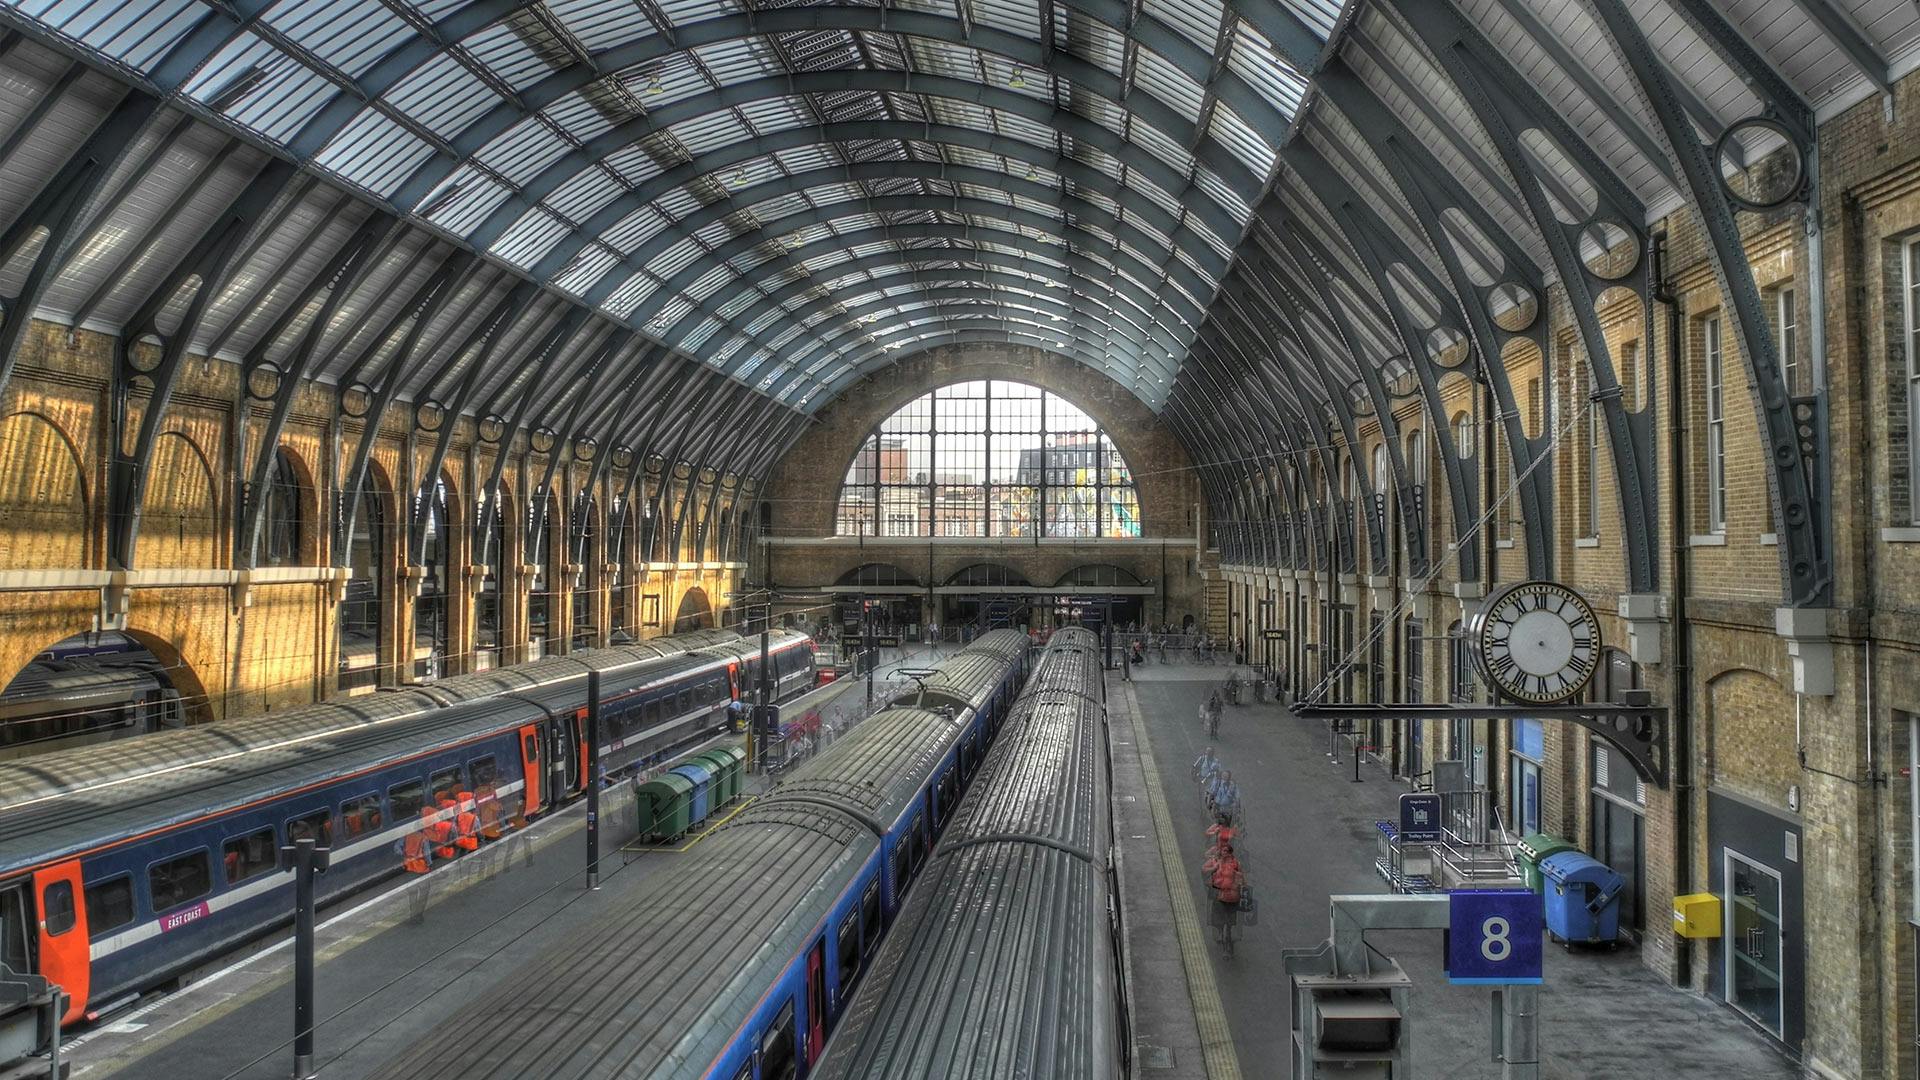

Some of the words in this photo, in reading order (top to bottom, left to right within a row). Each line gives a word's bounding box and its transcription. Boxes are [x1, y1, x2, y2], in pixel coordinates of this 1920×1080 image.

[1511, 596, 1527, 615] XI
[1533, 593, 1547, 609] XII
[1557, 600, 1568, 614] I
[1497, 614, 1513, 629] X
[1569, 615, 1586, 629] II
[1492, 637, 1508, 647] IX
[1574, 638, 1592, 648] III
[1494, 653, 1515, 674] VIII
[1567, 655, 1588, 674] IIII
[1511, 671, 1528, 689] VII
[1537, 676, 1548, 693] VI
[1557, 671, 1570, 688] V
[168, 915, 183, 928] EAST
[183, 908, 201, 923] COAST
[1481, 916, 1511, 961] 8
